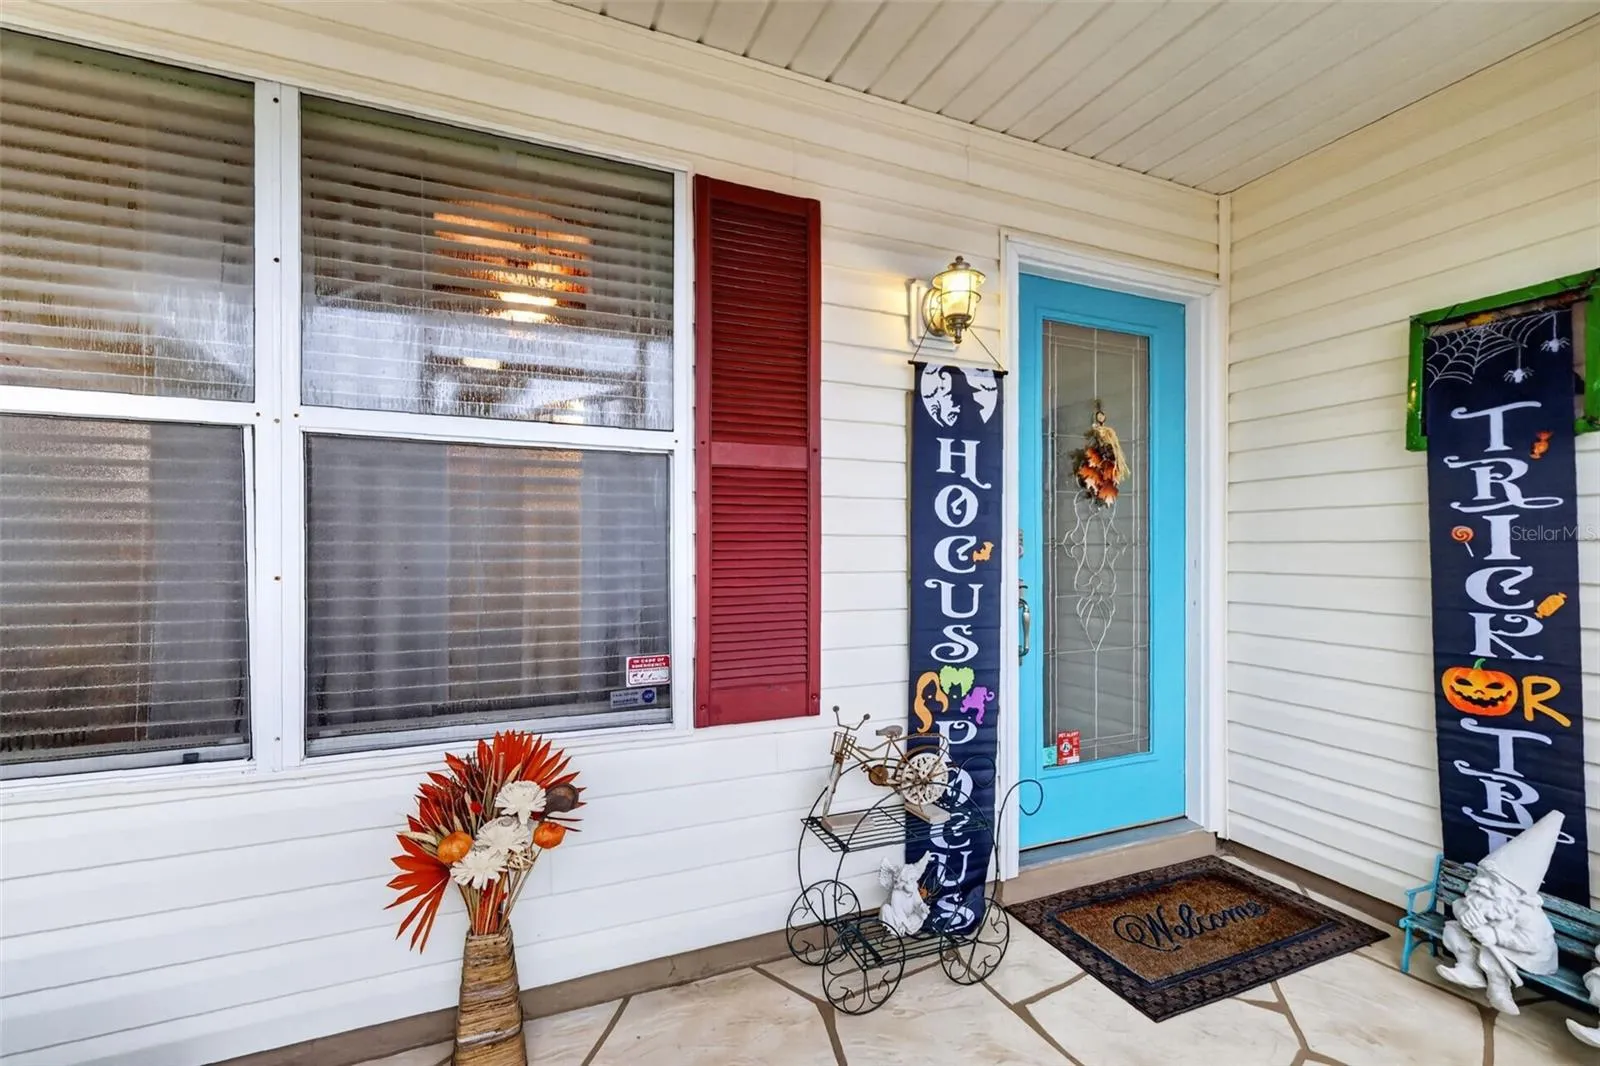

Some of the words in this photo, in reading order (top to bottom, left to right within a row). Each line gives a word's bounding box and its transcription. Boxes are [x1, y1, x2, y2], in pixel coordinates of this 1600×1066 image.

[924, 437, 992, 664] HOCUS
[1443, 401, 1564, 661] TRICK
[1113, 901, 1270, 951] Welcome
